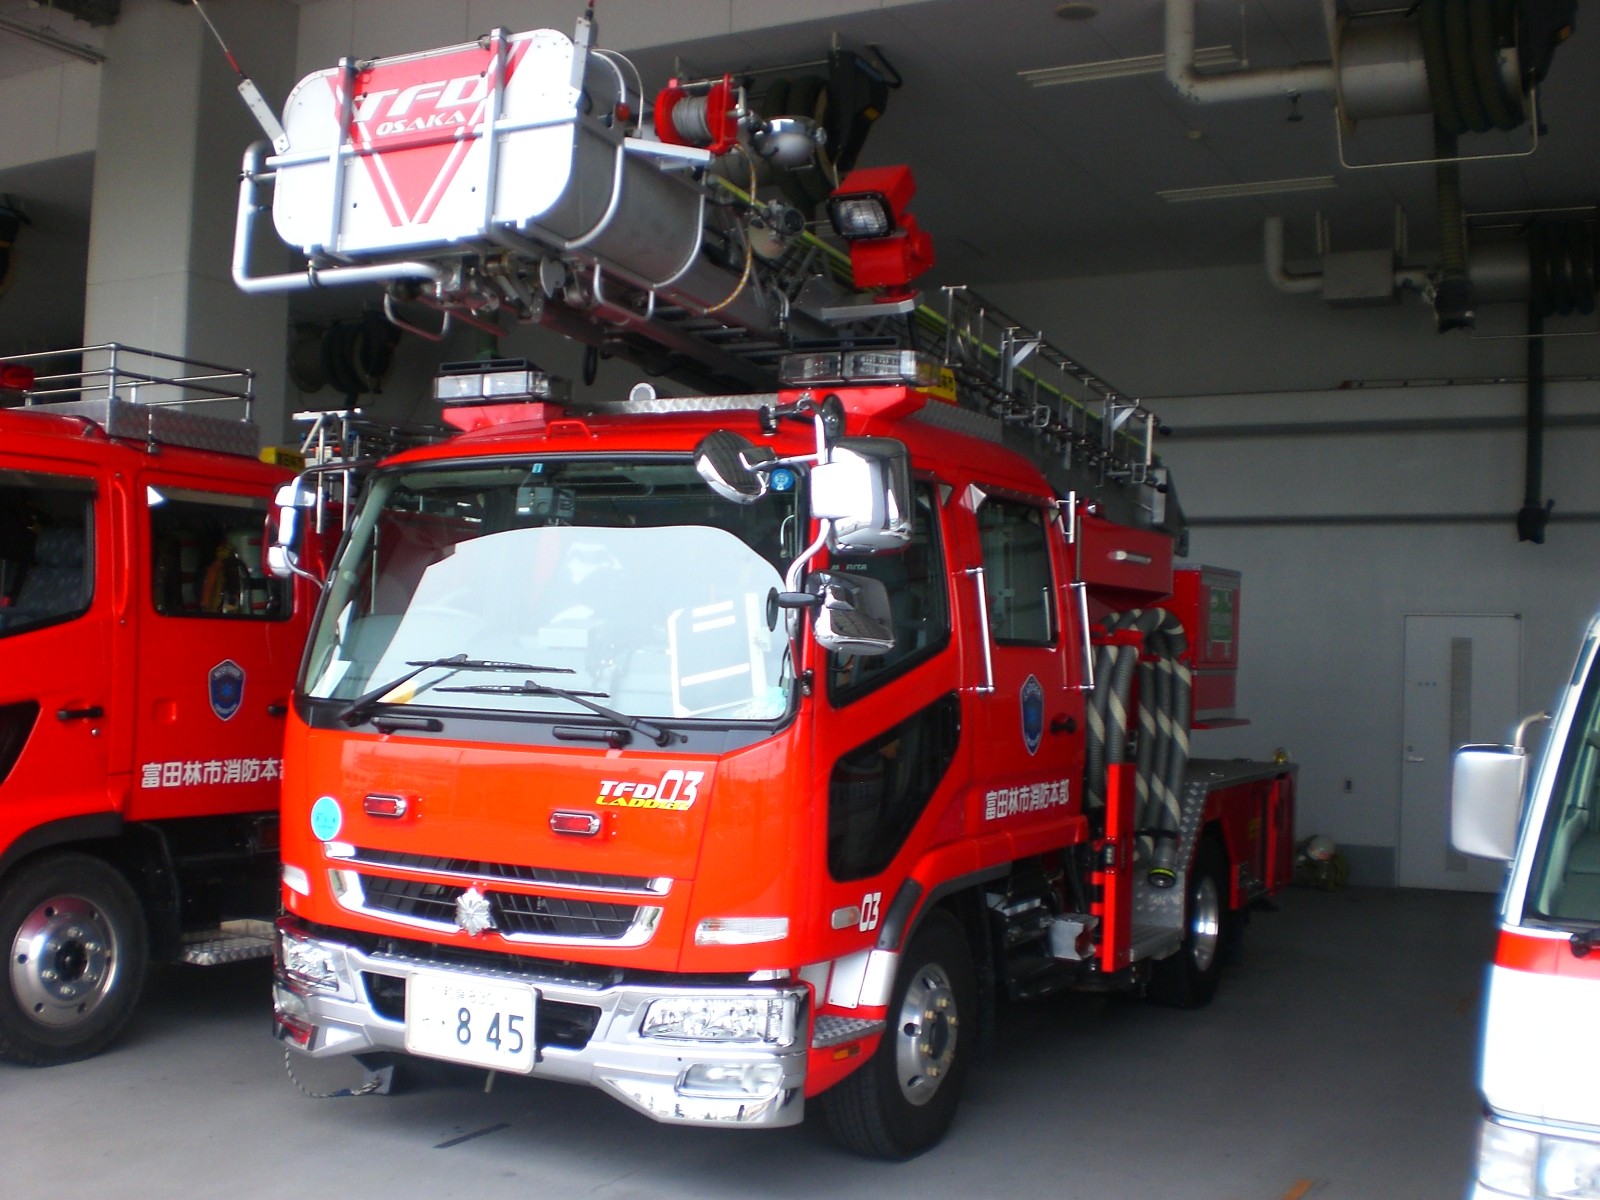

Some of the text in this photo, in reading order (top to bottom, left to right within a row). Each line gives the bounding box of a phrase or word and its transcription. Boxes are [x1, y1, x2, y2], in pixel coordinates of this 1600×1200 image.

[353, 73, 488, 122] TFD
[375, 110, 465, 136] OSAKA
[141, 757, 284, 788] 富田林市消防本
[985, 779, 1070, 820] 富田林市消防本部
[859, 892, 882, 932] 03
